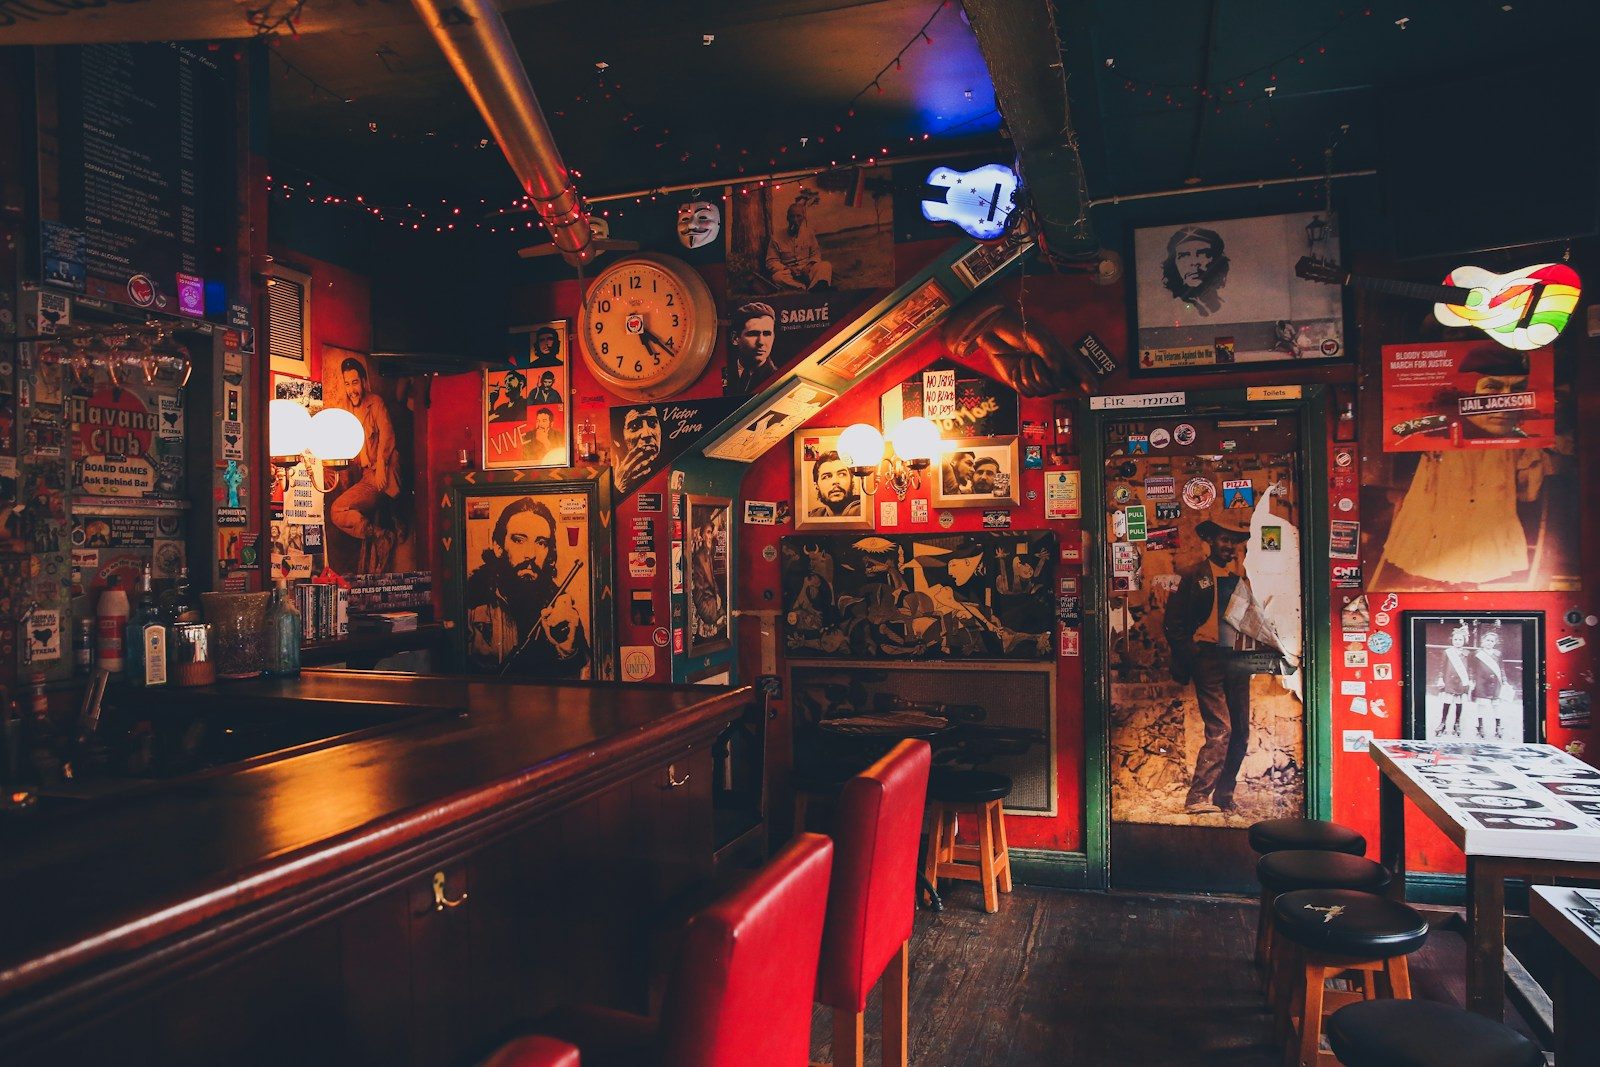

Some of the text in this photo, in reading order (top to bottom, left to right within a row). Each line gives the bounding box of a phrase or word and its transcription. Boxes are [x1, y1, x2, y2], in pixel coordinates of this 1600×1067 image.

[199, 56, 218, 69] Menu
[630, 276, 641, 289] 12
[653, 280, 658, 293] 1
[613, 284, 622, 297] 11
[666, 294, 674, 306] 2
[598, 300, 611, 314] 10
[780, 302, 830, 324] SABATÉ
[672, 315, 679, 327] 3
[595, 322, 603, 335] 9
[601, 342, 609, 355] 8
[665, 336, 675, 350] 4
[653, 352, 661, 366] 5
[1084, 335, 1116, 372] TOILETTES
[1182, 350, 1197, 361] Against
[1396, 350, 1447, 360] BLOODY SUNDAY
[617, 356, 624, 369] 7
[634, 360, 642, 373] 6
[1390, 359, 1453, 369] MARCH FOR JUSTICE
[1462, 395, 1532, 412] JAIL JACKSON
[73, 397, 159, 432] Havana
[663, 406, 698, 422] Victor
[670, 420, 703, 439] Jara
[91, 428, 140, 456] Club
[491, 424, 532, 455] VIVE
[85, 464, 148, 476] BOARD GAMES
[84, 477, 149, 488] Ask Behind Bar
[1226, 480, 1249, 488] PIZZA
[294, 489, 312, 497] SCRABBLE
[1146, 486, 1174, 495] AMNISTIA
[1333, 566, 1359, 577] CNT
